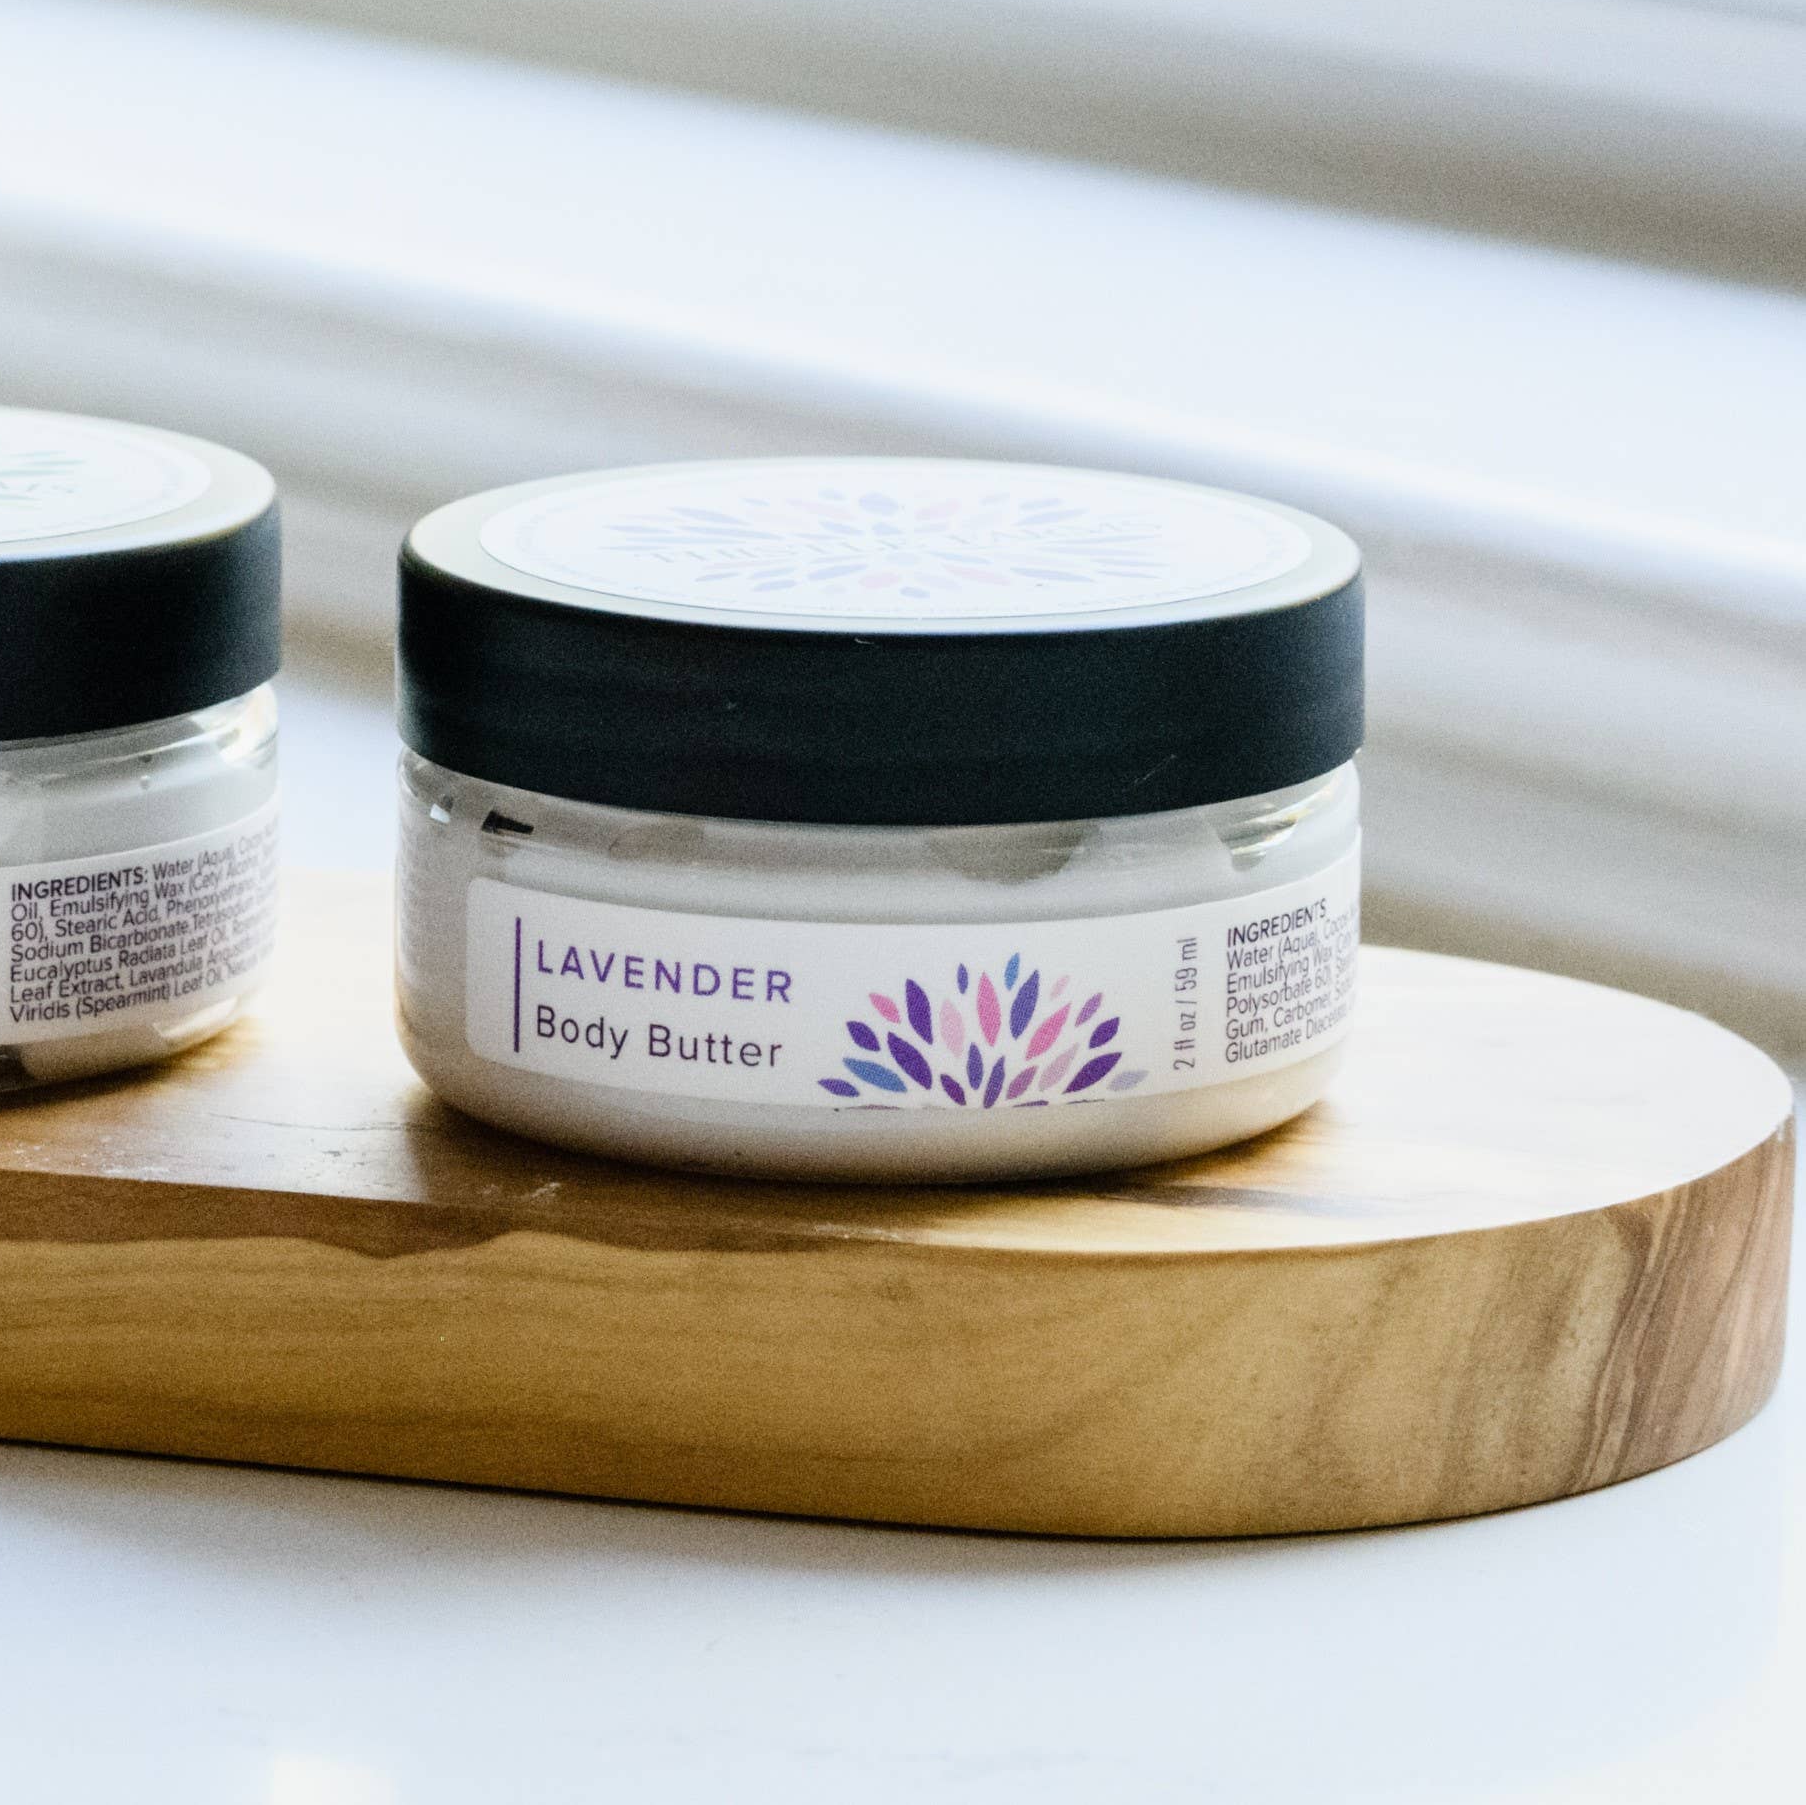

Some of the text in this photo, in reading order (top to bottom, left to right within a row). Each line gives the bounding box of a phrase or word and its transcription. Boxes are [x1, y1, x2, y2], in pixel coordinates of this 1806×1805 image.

[11, 865, 148, 902] INGREDIENTS:
[152, 858, 194, 881] Water
[11, 901, 43, 923] Oil,
[50, 888, 150, 918] Emulsifying
[154, 881, 185, 900] Wax
[11, 921, 48, 943] 60),
[55, 913, 117, 938] Stearic
[10, 956, 112, 983] Eucalyptus
[118, 943, 176, 969] Radiata
[180, 934, 208, 955] Leaf
[11, 941, 84, 964] Sodium
[1176, 937, 1198, 961] ml
[1226, 944, 1274, 971] Water
[10, 979, 53, 1003] Leaf
[58, 972, 125, 998] Extract,
[130, 955, 203, 988] Lavandula
[537, 940, 792, 1004] LAVENDER
[1175, 967, 1198, 992] 59
[1226, 954, 1309, 995] Emulsifying
[10, 1000, 71, 1023] Viridis
[76, 984, 170, 1020] (Spearmint)
[174, 975, 203, 997] Leaf
[1226, 977, 1312, 1018] Polysorbate
[536, 1006, 784, 1069] Body Butter
[1180, 1012, 1196, 1031] oz
[1226, 1017, 1268, 1040] Gum,
[1225, 1026, 1302, 1063] Glutamate
[1173, 1060, 1195, 1071] 2
